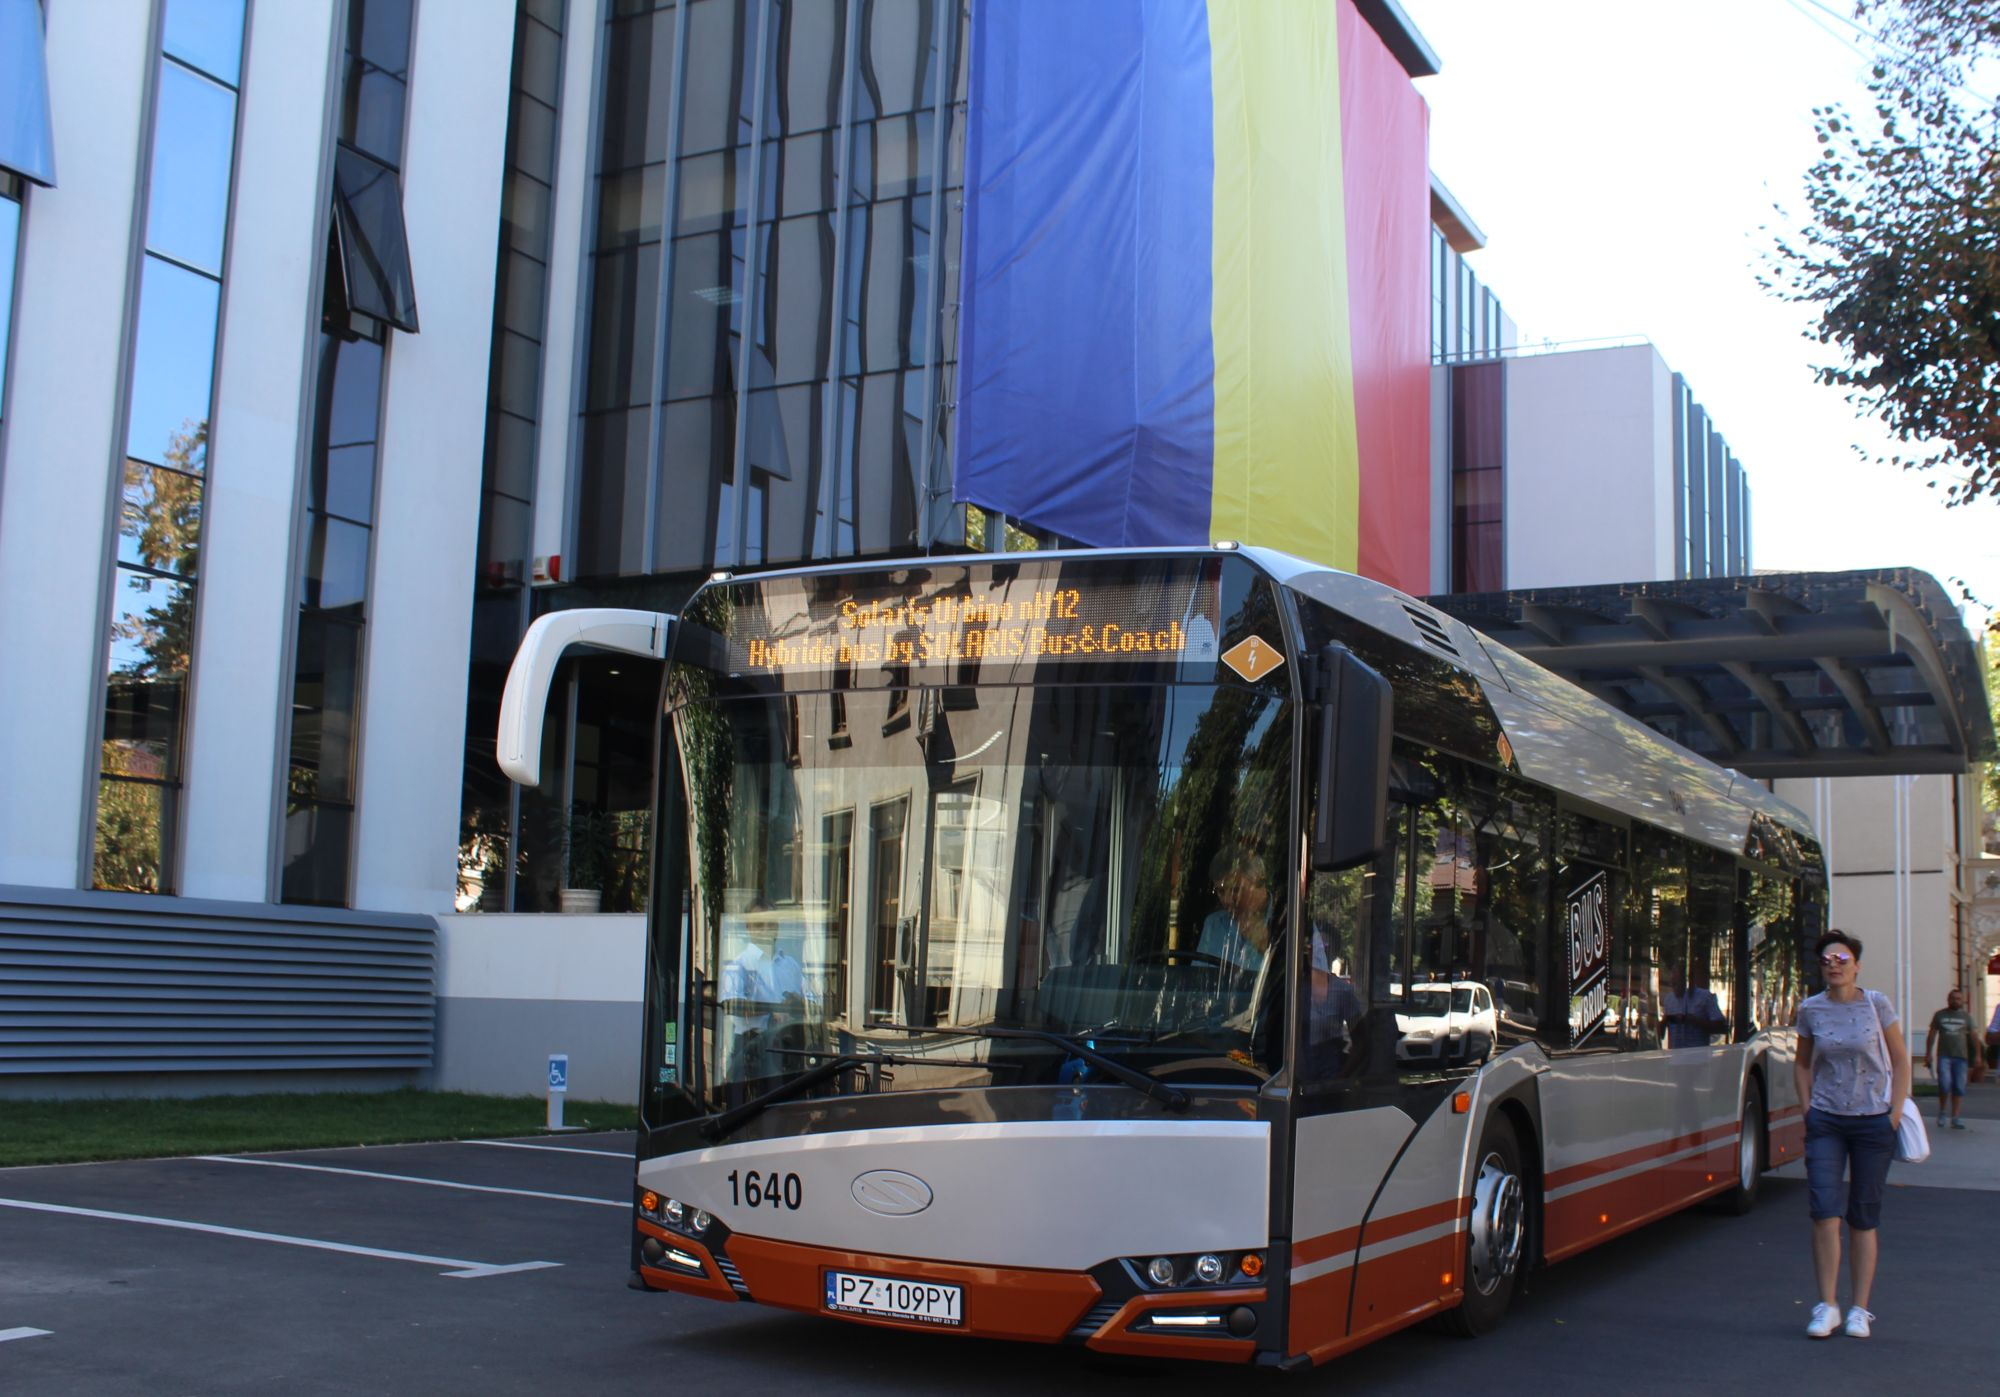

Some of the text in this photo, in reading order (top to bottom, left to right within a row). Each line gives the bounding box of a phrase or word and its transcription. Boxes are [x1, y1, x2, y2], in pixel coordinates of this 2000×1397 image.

[841, 597, 929, 629] Solaris
[934, 593, 1014, 626] Urbino
[748, 620, 1186, 669] Hybride bus by SOLARIS Bus&Coach
[1570, 883, 1604, 980] BUS
[727, 1169, 802, 1211] 1640
[840, 1277, 956, 1316] PZ 109PY
